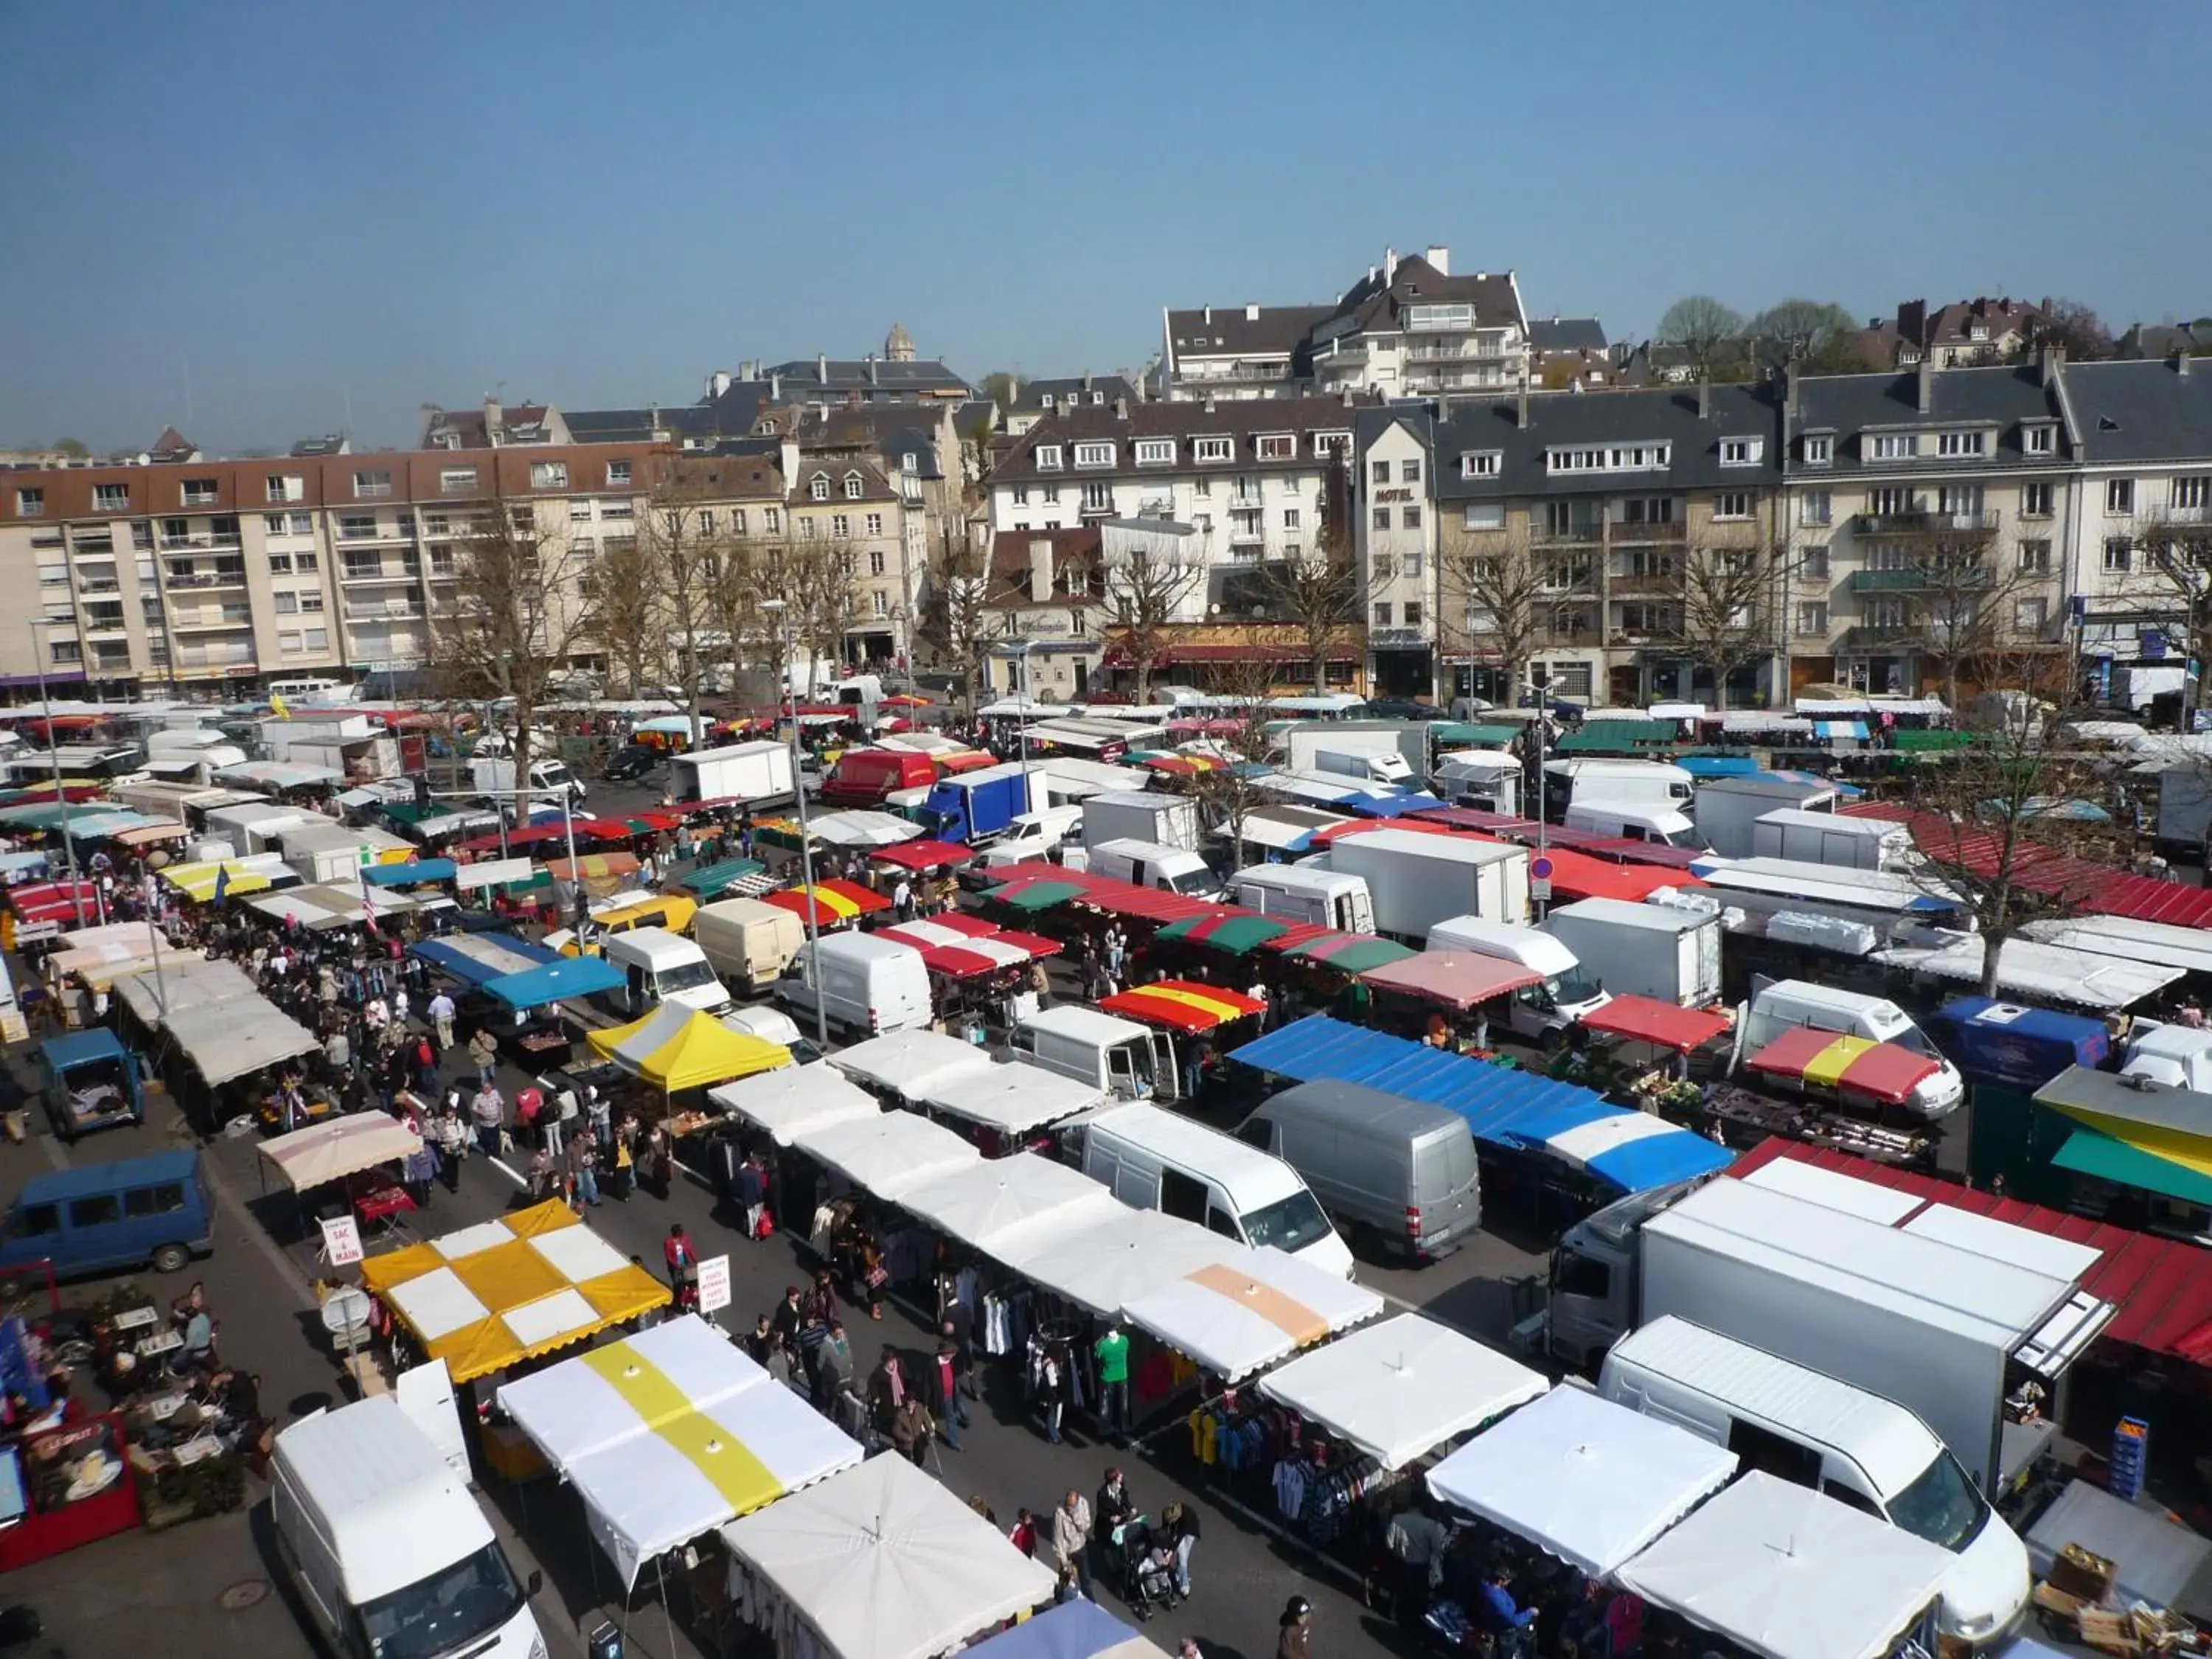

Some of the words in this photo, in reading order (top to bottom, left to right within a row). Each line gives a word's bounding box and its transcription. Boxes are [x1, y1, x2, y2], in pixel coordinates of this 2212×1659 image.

[1376, 488, 1415, 503] HOTEL
[333, 1226, 349, 1239] SAC
[335, 1248, 359, 1262] MAIN
